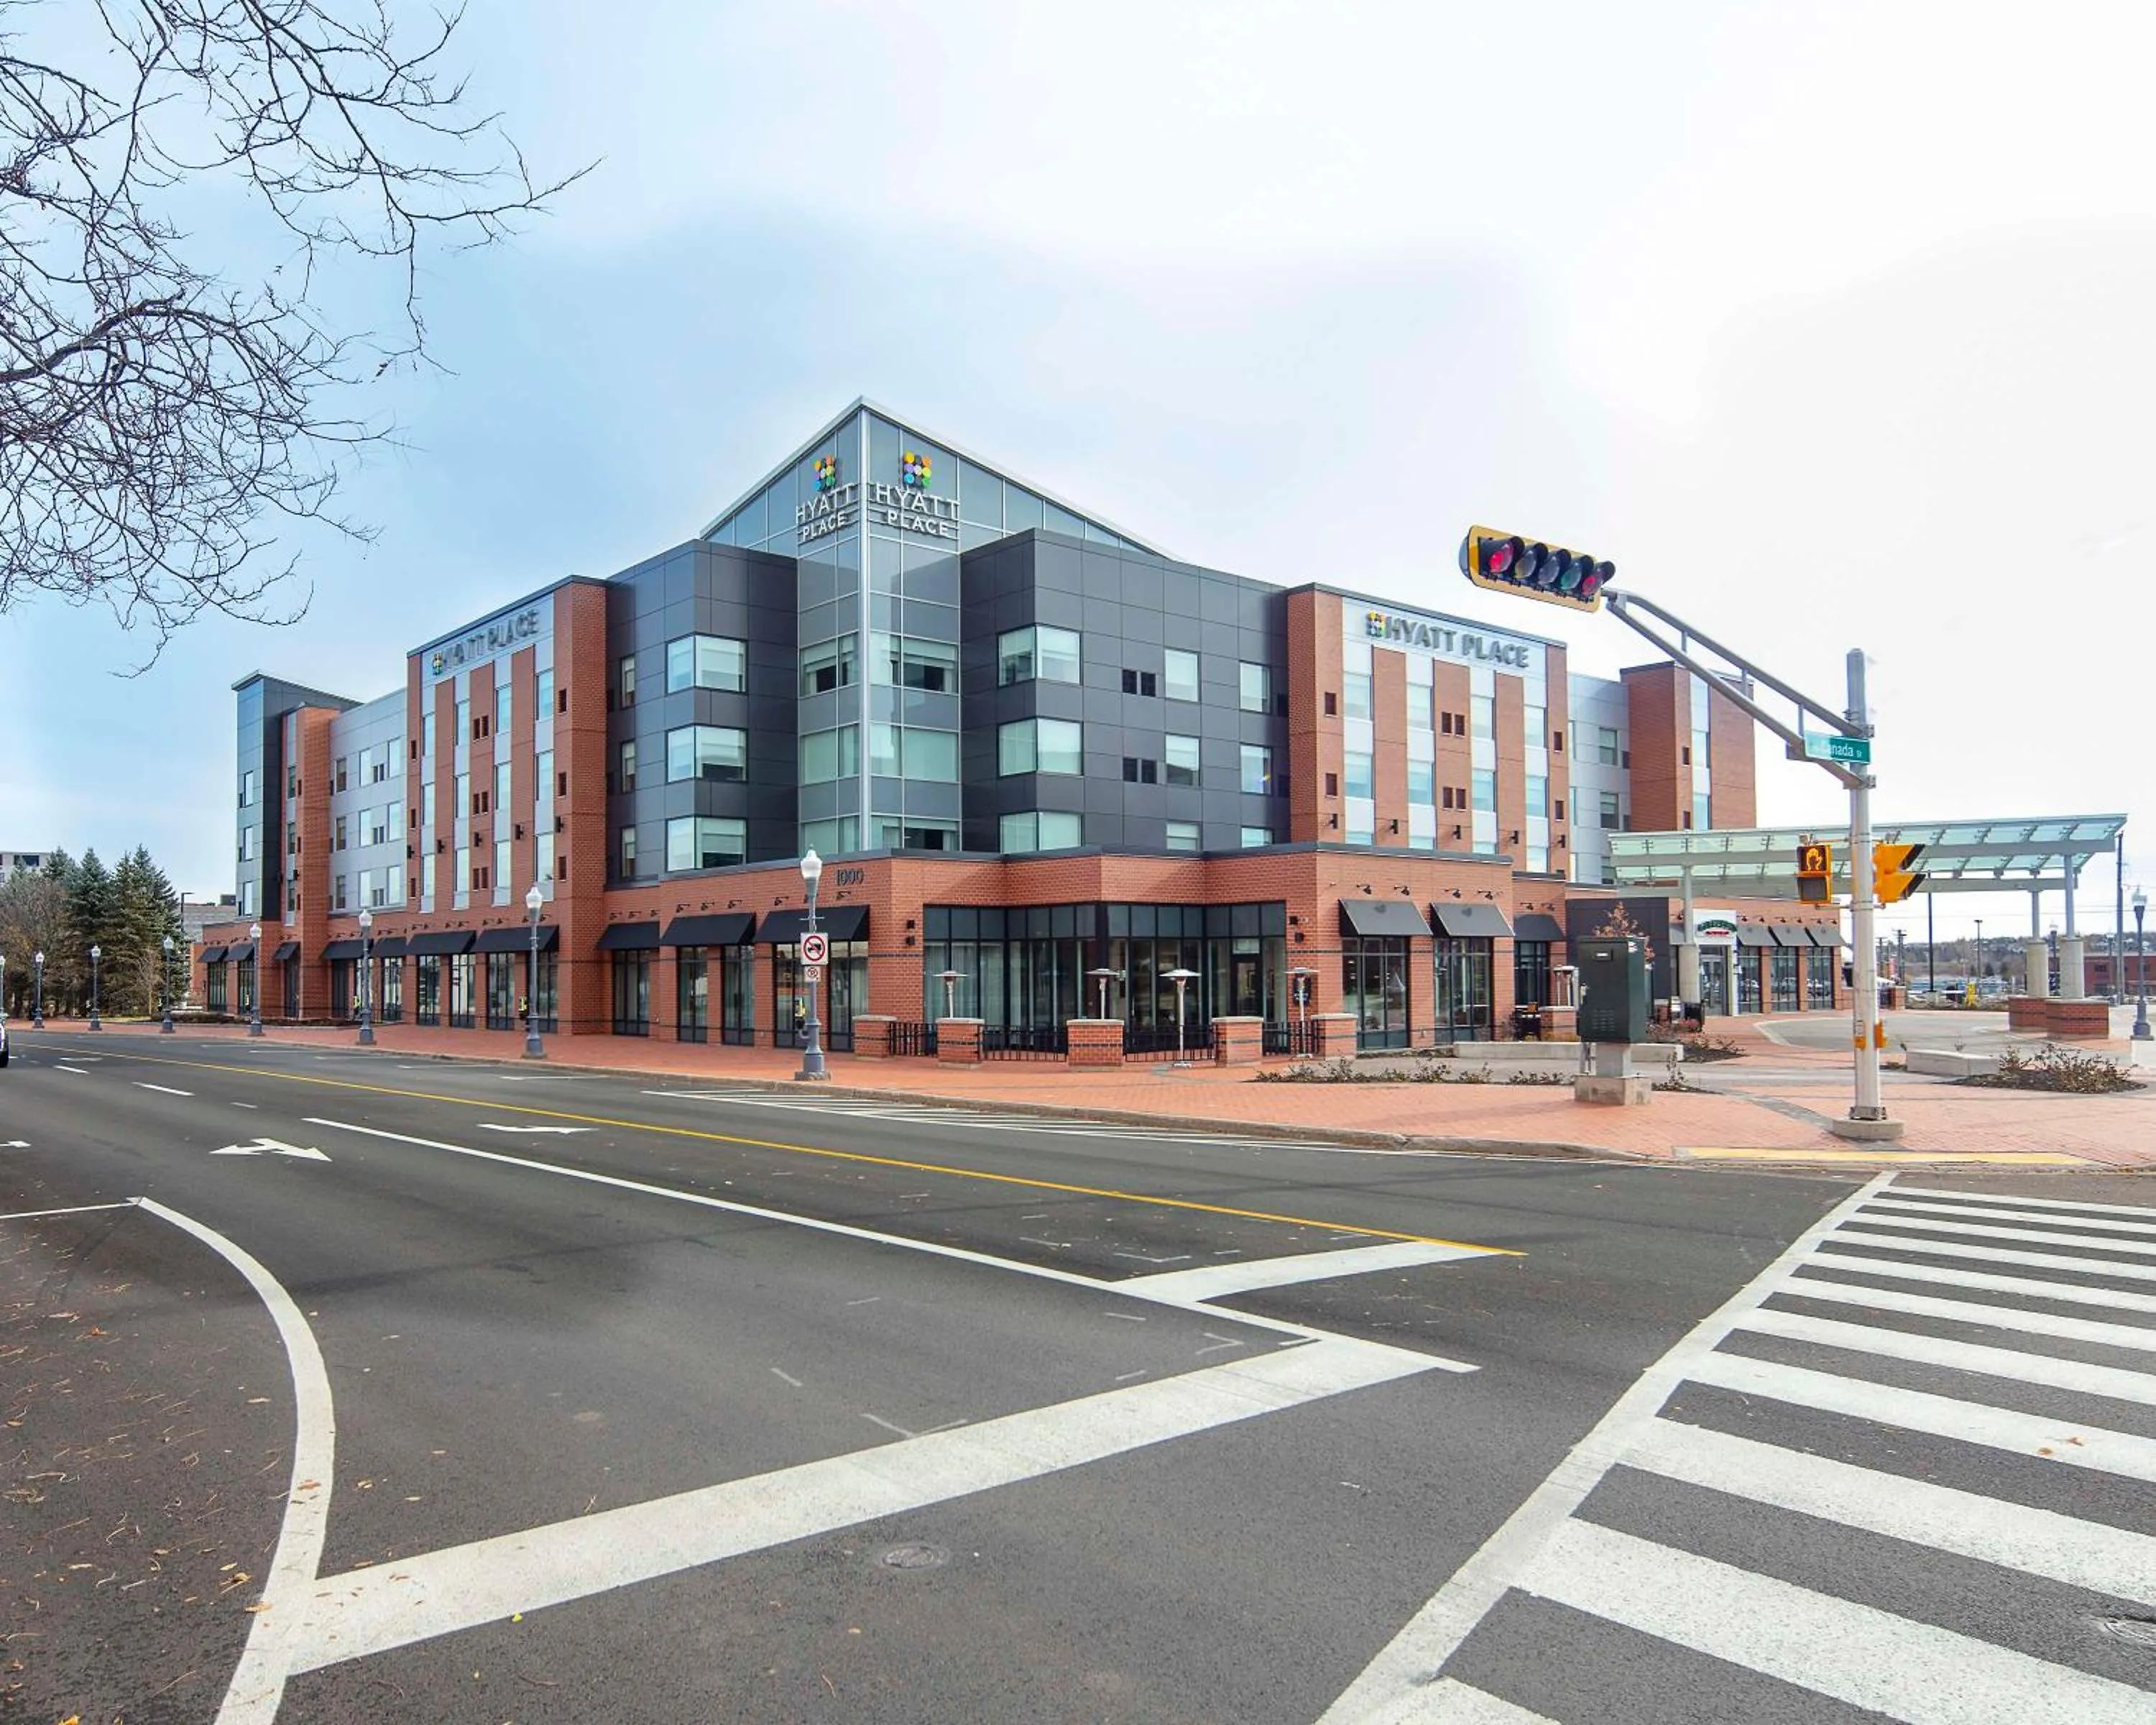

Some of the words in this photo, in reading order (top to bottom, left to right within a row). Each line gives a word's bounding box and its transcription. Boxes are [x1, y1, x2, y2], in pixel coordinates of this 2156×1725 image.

[796, 483, 855, 525] HYATT
[875, 483, 959, 519] HYATT
[802, 510, 847, 540] PLACE
[887, 510, 949, 536] PLACE
[487, 610, 538, 651] PLACE
[1386, 616, 1457, 652] HYATT
[1461, 633, 1529, 668] PLACE
[837, 868, 865, 886] 1000
